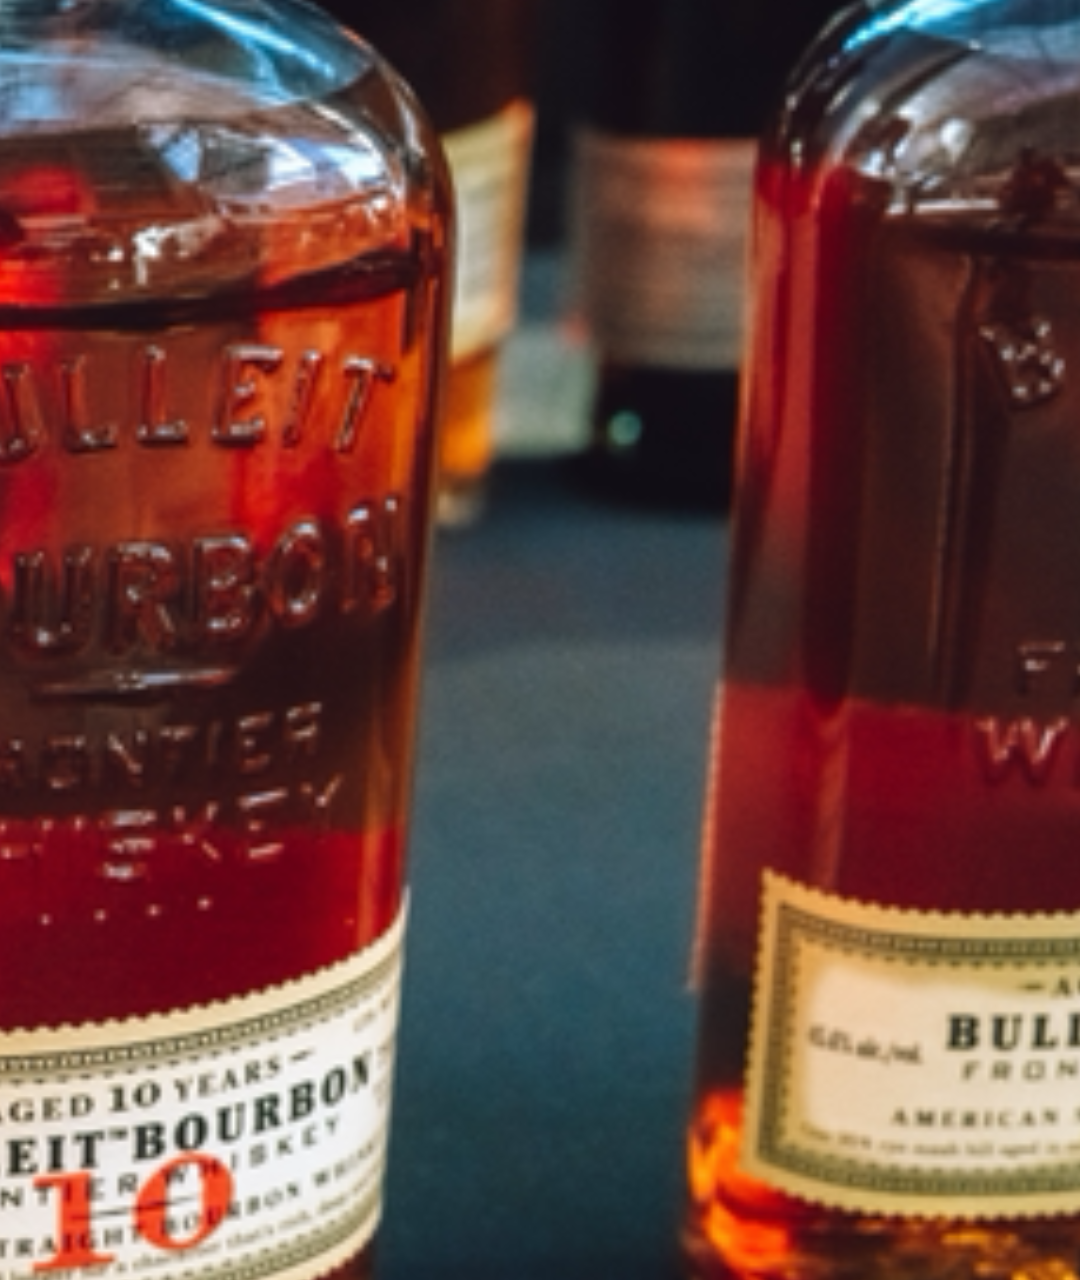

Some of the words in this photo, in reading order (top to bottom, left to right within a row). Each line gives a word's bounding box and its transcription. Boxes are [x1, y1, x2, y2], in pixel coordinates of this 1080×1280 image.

[110, 1080, 162, 1113] 10
[174, 1056, 281, 1102] YEARS
[133, 1051, 373, 1160] BOURBON
[893, 1107, 1058, 1128] AMERICAN
[32, 1150, 236, 1274] 10
